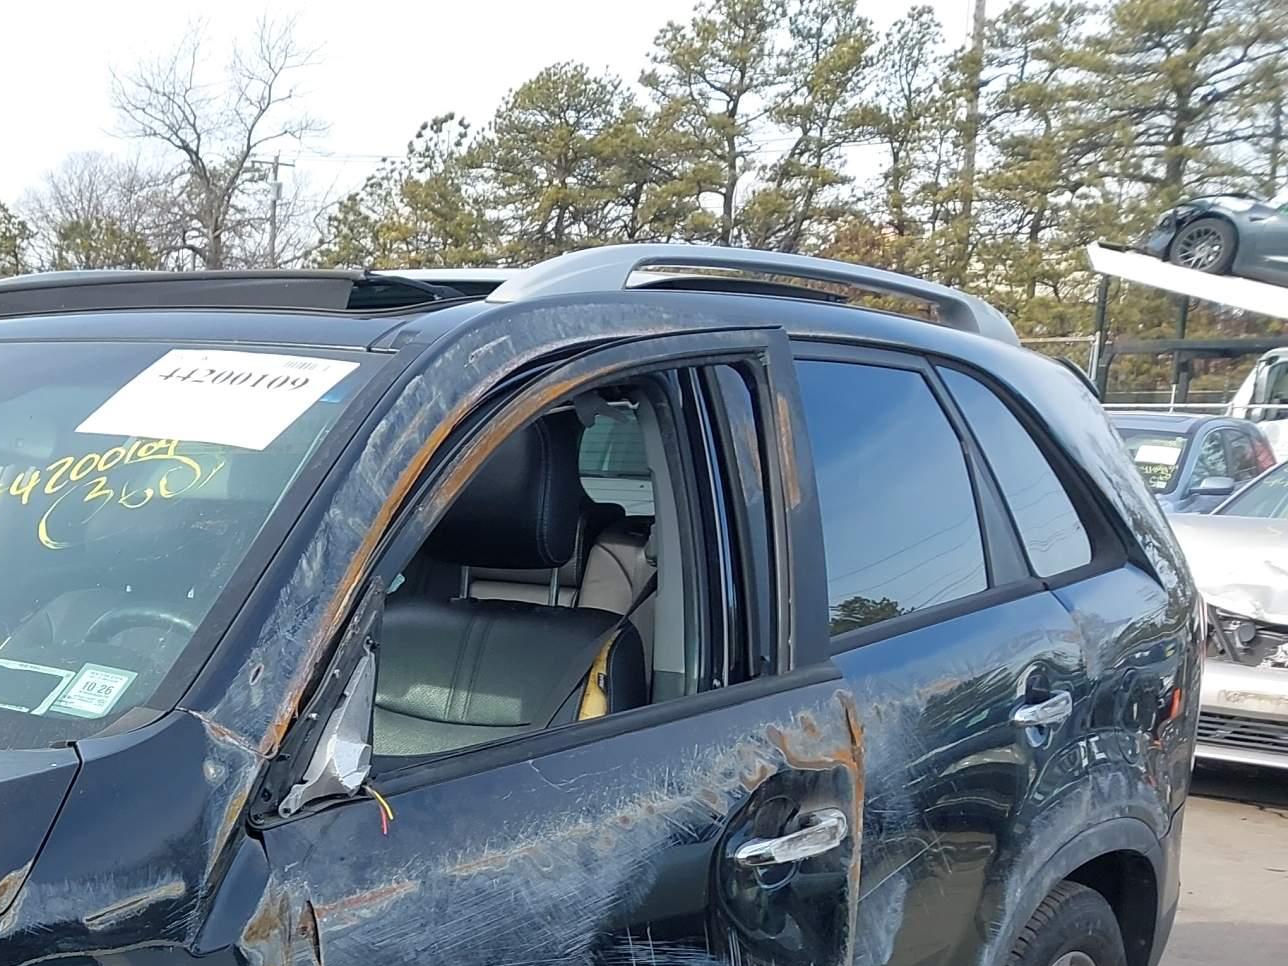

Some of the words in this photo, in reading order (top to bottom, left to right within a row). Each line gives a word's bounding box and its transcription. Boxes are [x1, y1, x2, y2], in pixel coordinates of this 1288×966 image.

[158, 366, 311, 391] 44200109
[82, 681, 97, 692] 10
[97, 684, 114, 695] 26
